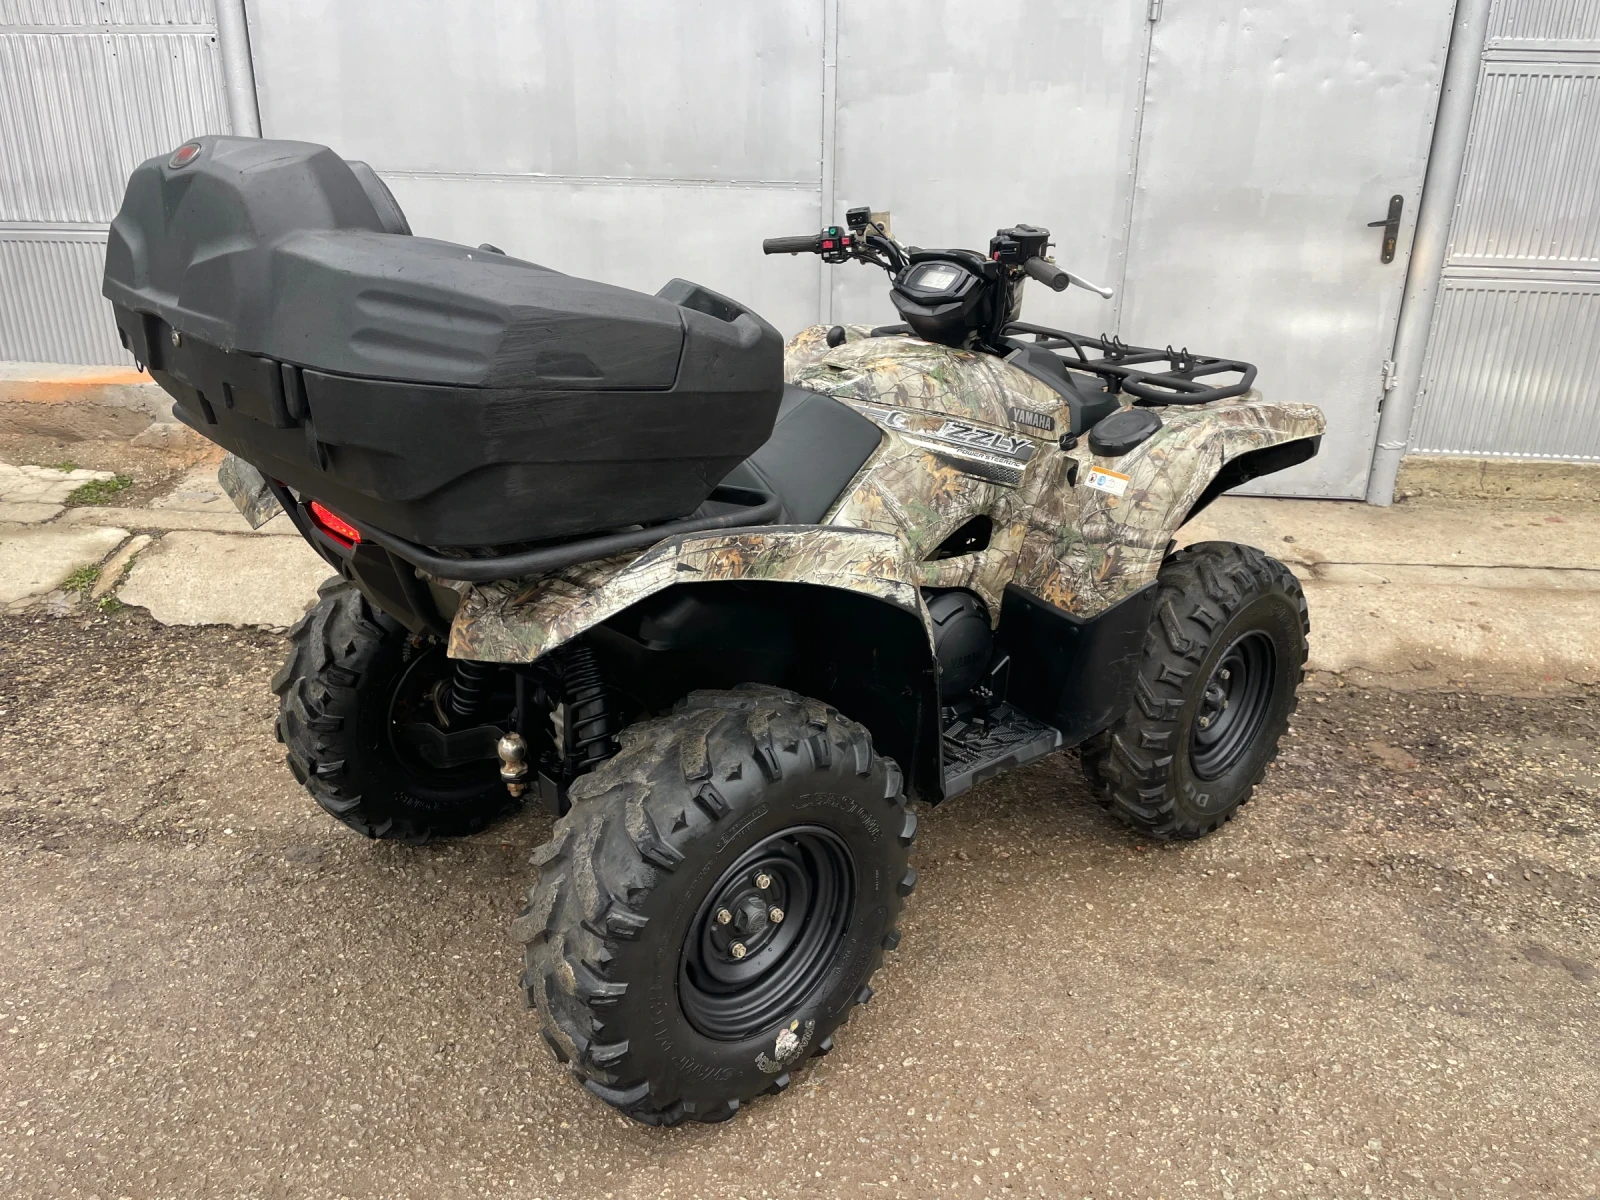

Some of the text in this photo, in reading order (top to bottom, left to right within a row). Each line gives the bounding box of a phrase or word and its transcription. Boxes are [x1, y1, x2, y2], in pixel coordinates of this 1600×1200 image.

[1013, 407, 1051, 431] YAMAHA
[956, 447, 1022, 467] POWER STEERING
